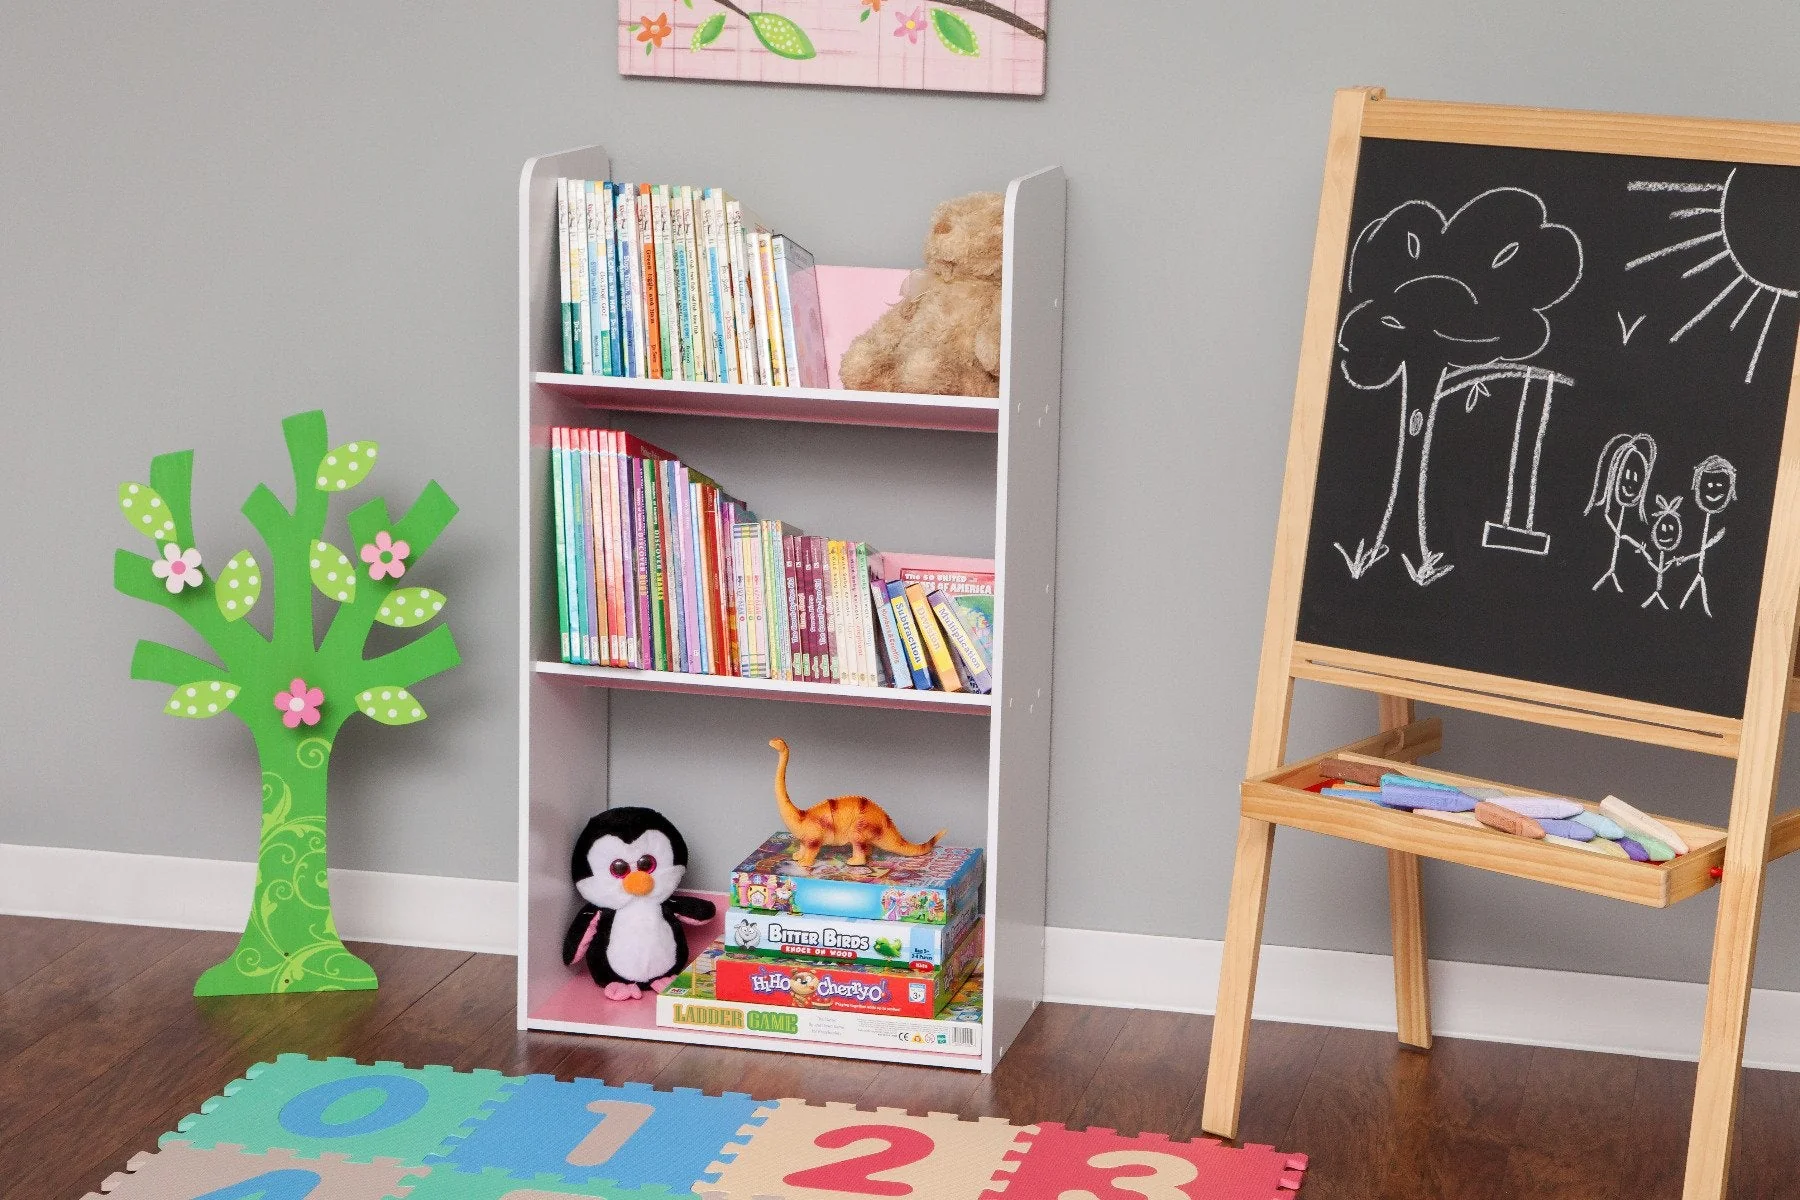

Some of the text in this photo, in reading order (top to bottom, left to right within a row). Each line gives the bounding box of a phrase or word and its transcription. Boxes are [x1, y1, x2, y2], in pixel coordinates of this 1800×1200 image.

[950, 583, 992, 594] AMERICA
[895, 602, 922, 664] Subtraction
[916, 607, 941, 651] Division
[938, 607, 981, 669] Multiplication
[769, 923, 870, 950] BITTER BIRDS
[673, 1003, 745, 1030] LADDER
[747, 1010, 799, 1035] GAME
[278, 1074, 430, 1139] 0
[565, 1100, 656, 1166] 1
[782, 1124, 935, 1196] 2
